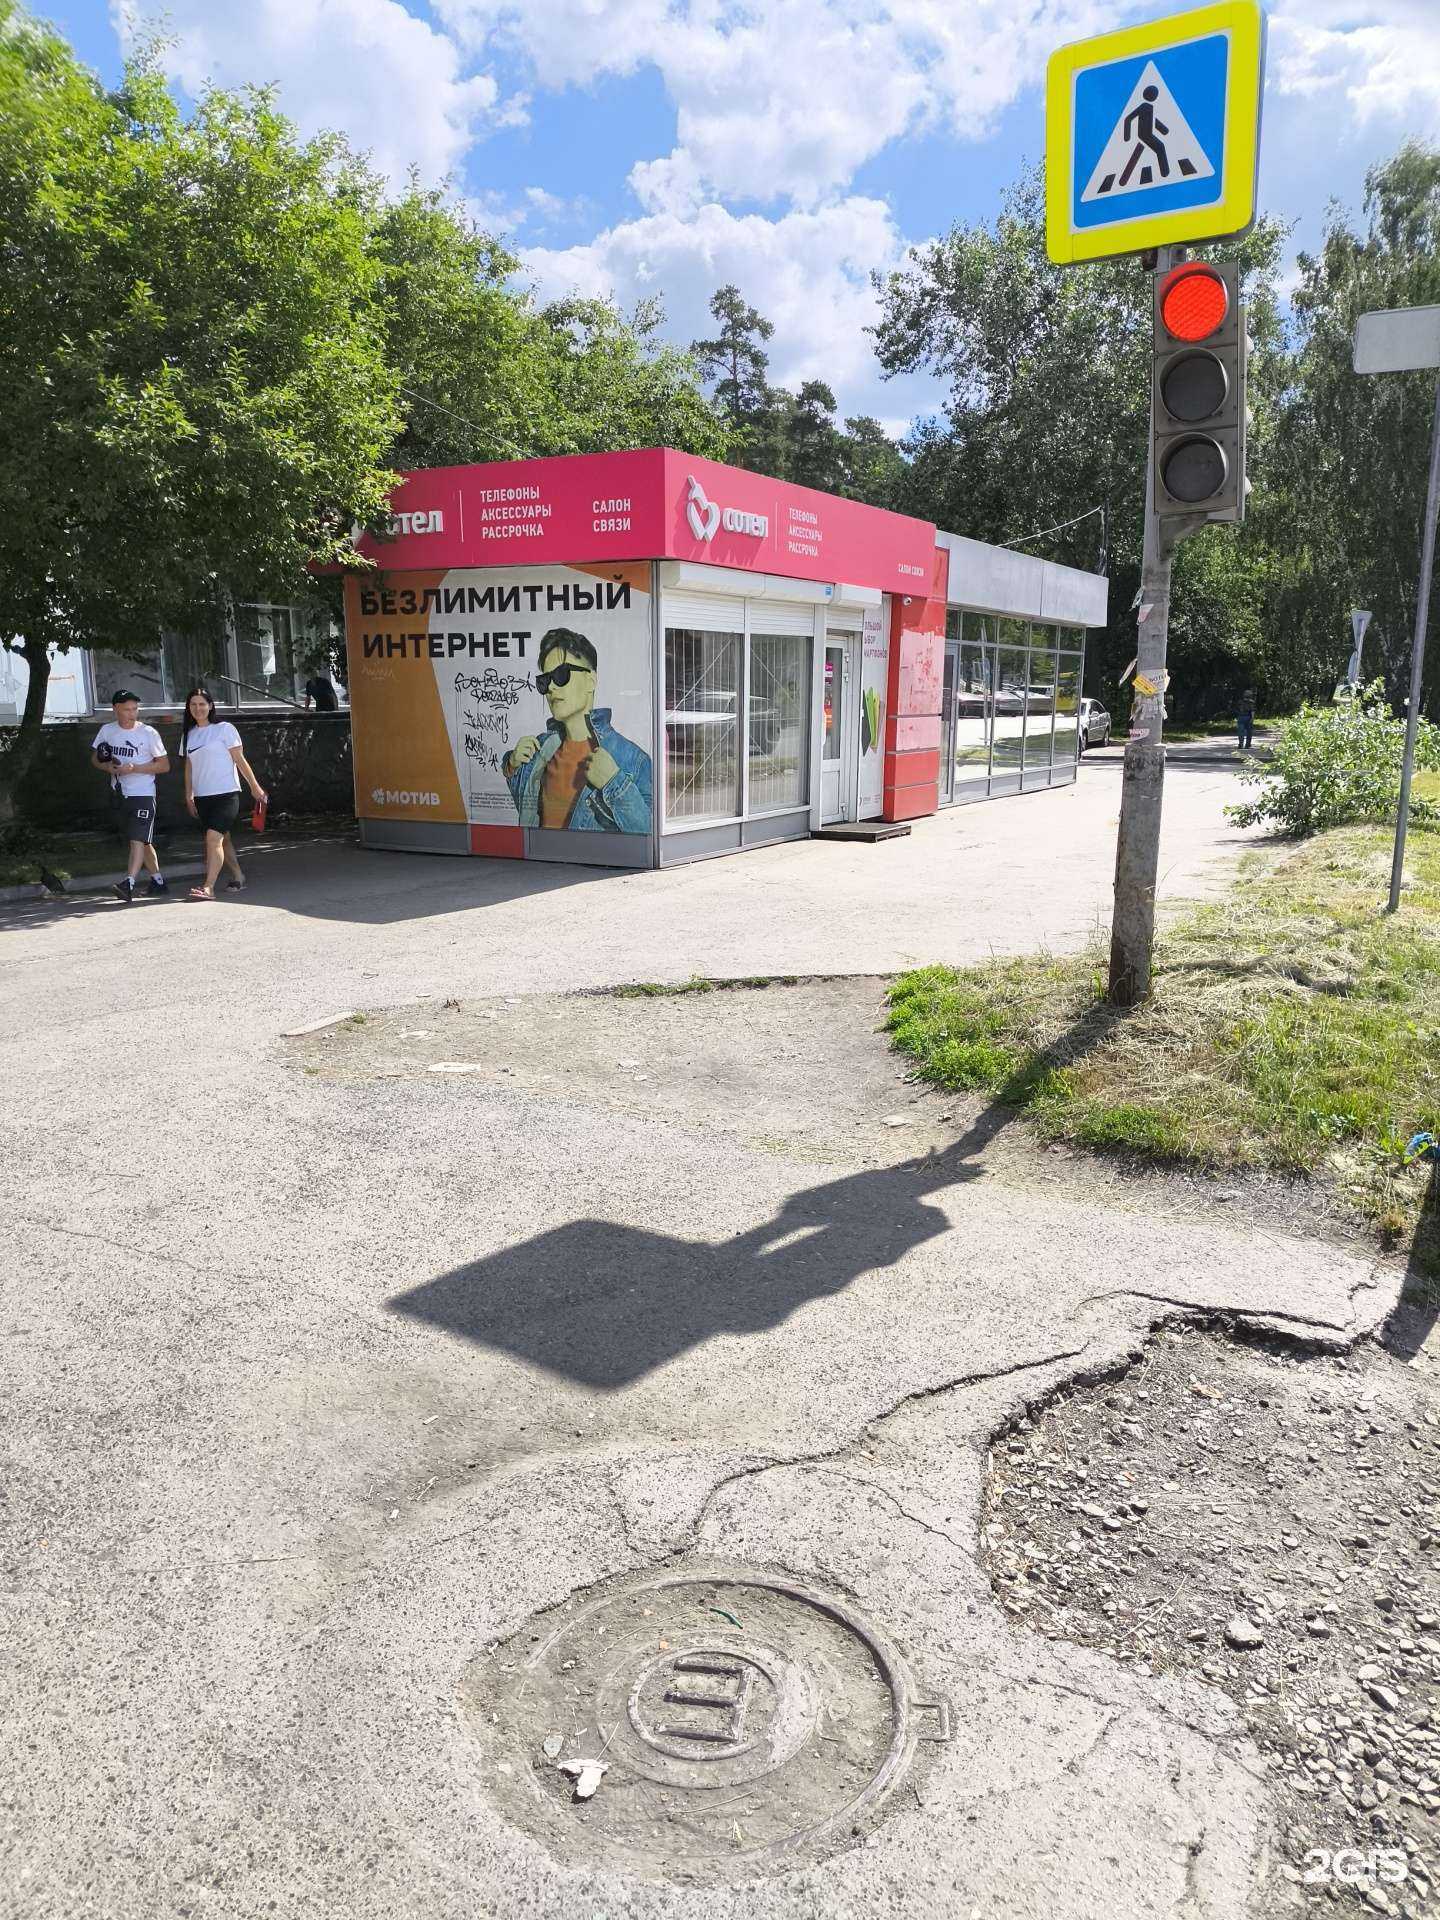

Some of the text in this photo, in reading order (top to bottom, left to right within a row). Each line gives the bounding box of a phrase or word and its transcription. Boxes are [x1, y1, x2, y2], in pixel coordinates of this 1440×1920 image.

[480, 486, 540, 502] ТЕЛЕФОНЫ
[481, 503, 552, 521] АКСЕССУАРЫ
[592, 498, 631, 513] САЛОН
[384, 510, 444, 537] отел
[592, 517, 631, 532] СВЯЗИ
[788, 507, 818, 525] ТЕЛЕФОНЫ
[482, 523, 544, 539] РАССРОЧКА
[360, 573, 631, 616] БЕЗЛИМИТНЫЙ
[363, 632, 532, 659] ИНТЕРНЕТ
[386, 790, 440, 806] МОТИВ
